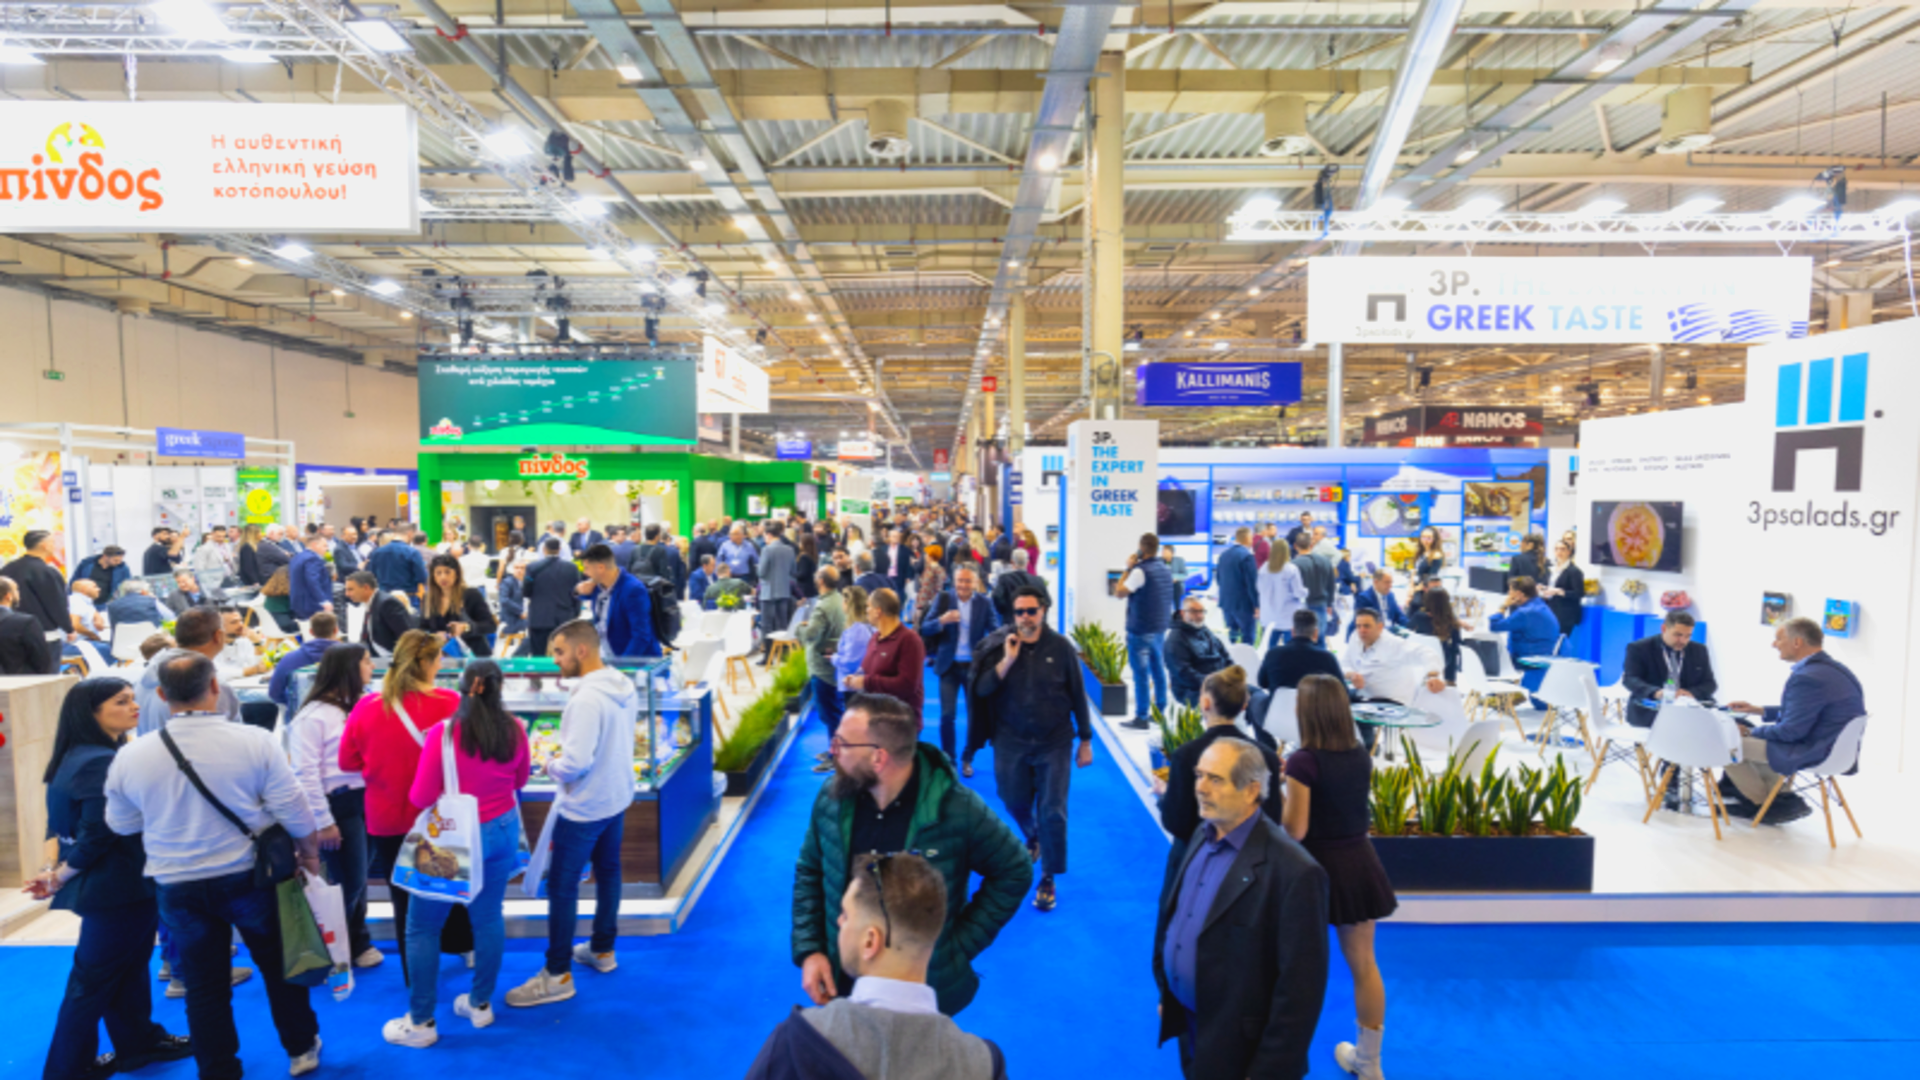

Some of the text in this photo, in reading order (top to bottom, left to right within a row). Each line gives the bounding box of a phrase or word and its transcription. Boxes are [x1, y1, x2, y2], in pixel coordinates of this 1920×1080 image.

[211, 134, 342, 154] Η αυθεντική
[213, 157, 377, 179] ελληνική γεύση
[0, 153, 163, 211] πίνδος
[213, 182, 346, 200] κοτόπουλου!
[1428, 270, 1480, 297] 3P.
[1426, 304, 1643, 331] GREEK TASTE
[1176, 371, 1271, 389] KALLIMANIS
[1463, 412, 1527, 429] NANOS
[1092, 432, 1116, 444] 3P.
[1092, 446, 1118, 458] THE
[518, 453, 588, 478] πίνδος
[1092, 460, 1144, 473] EXPERT
[1092, 475, 1109, 487] IN
[1091, 489, 1138, 503] GREEK
[1091, 503, 1133, 517] TASTE
[1748, 500, 1900, 536] 3psalads.gr
